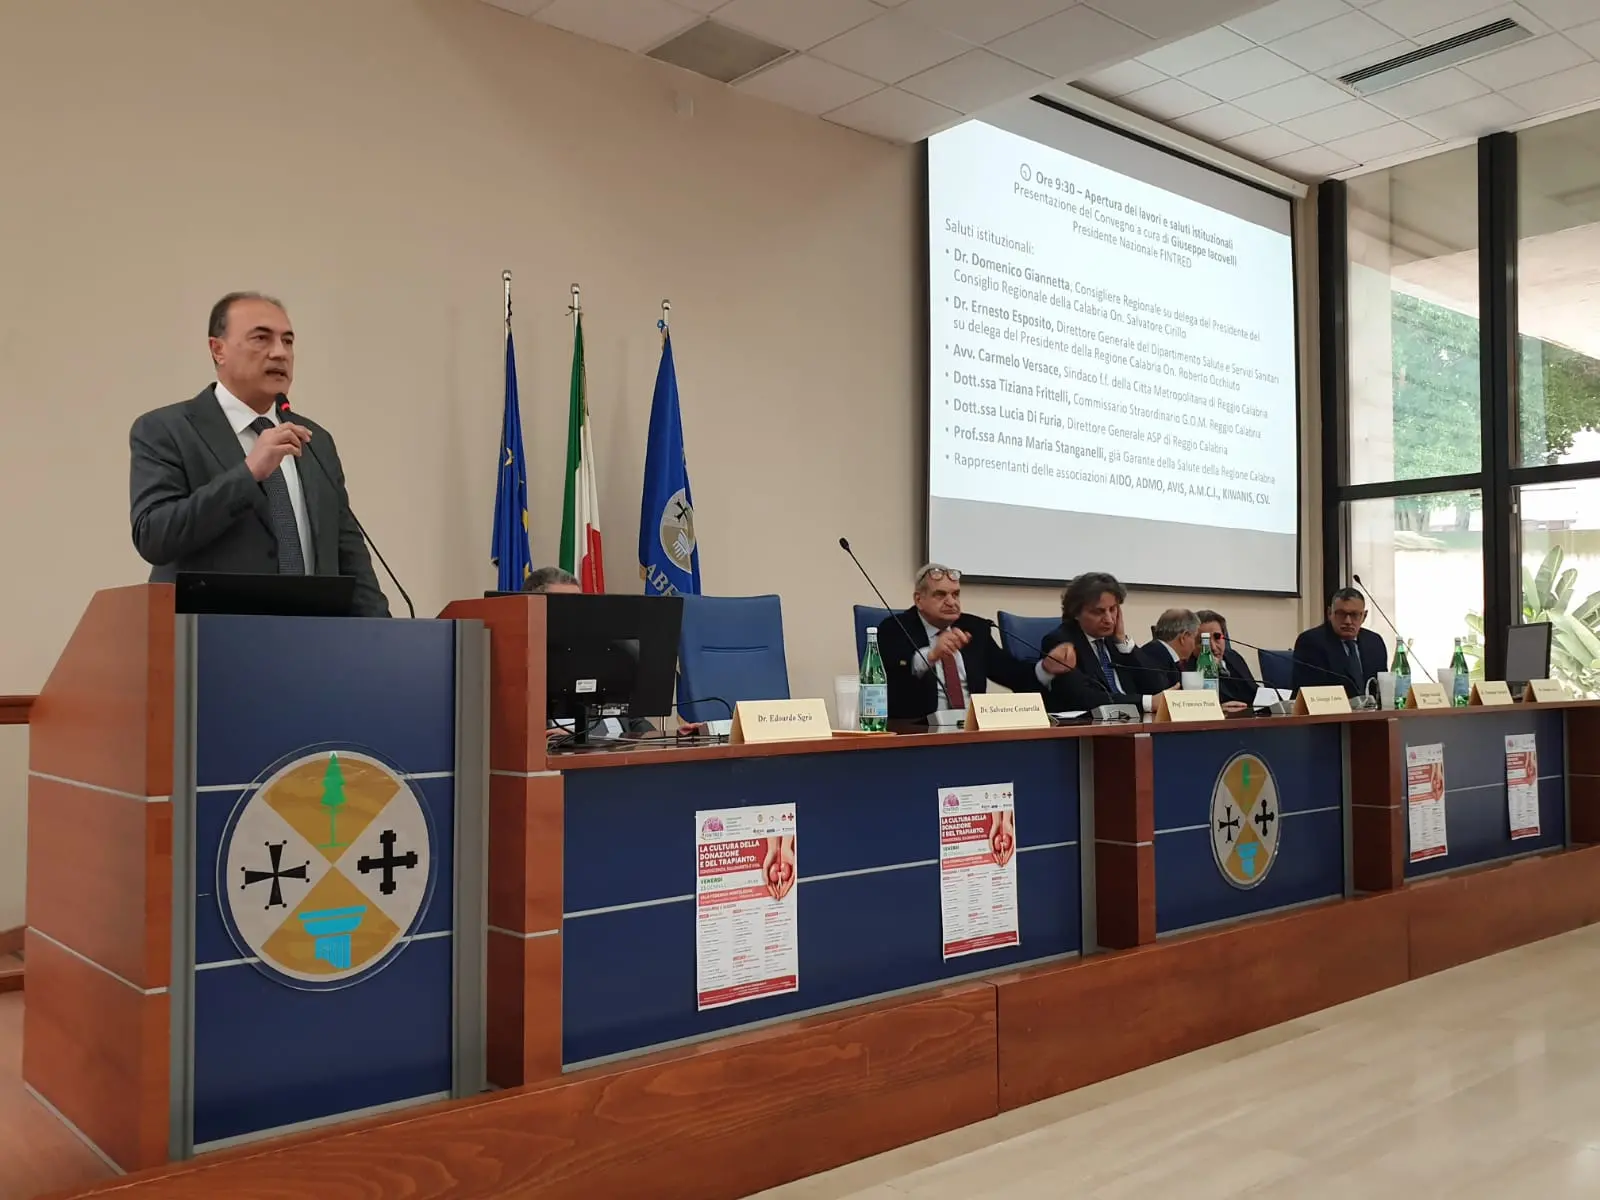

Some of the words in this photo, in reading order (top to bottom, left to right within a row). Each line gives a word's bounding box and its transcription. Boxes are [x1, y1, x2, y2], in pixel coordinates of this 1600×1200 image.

[945, 216, 973, 237] Saluti
[976, 225, 1034, 255] istituzionali:
[1014, 181, 1076, 214] Presentazione
[1079, 203, 1092, 219] del
[1094, 209, 1134, 232] Convegno
[1143, 228, 1160, 241] cura
[1161, 231, 1169, 244] di
[1170, 234, 1206, 257] Giuseppe
[1036, 170, 1053, 187] Ore
[1055, 176, 1074, 195] 9:30
[1084, 187, 1122, 211] Apertura
[1139, 206, 1161, 225] lavori
[1169, 220, 1190, 235] saluti
[1192, 225, 1233, 249] istituzionali
[1072, 220, 1117, 245] Presidente
[1119, 235, 1157, 258] Nazionale
[953, 267, 999, 291] Consiglio
[1001, 280, 1047, 303] Regionale
[1049, 292, 1070, 309] della
[1073, 298, 1107, 318] Calabria
[1110, 308, 1124, 322] On.
[1126, 313, 1162, 332] Salvatore
[954, 247, 968, 264] Dr.
[971, 252, 1022, 278] Domenico
[1024, 266, 1072, 292] Giannetta,
[1074, 281, 1120, 304] Consigliere
[1123, 294, 1161, 315] Regionale
[1162, 308, 1171, 318] su
[1173, 308, 1197, 326] delega
[1212, 319, 1248, 339] Presidente
[953, 295, 968, 311] Dr.
[971, 299, 1009, 320] Ernesto
[1012, 309, 1053, 331] Esposito,
[1056, 320, 1095, 340] Direttore
[1097, 330, 1134, 349] Generale
[1151, 343, 1200, 364] Dipartimento
[1202, 355, 1224, 371] Salute
[953, 318, 964, 330] su
[968, 318, 1000, 339] delega
[1003, 326, 1018, 341] del
[1020, 330, 1069, 352] Presidente
[1071, 341, 1092, 357] della
[1094, 347, 1127, 365] Regione
[1129, 355, 1160, 372] Calabria
[1163, 363, 1176, 376] On.
[1178, 366, 1207, 383] Roberto
[1209, 374, 1240, 391] Occhiuto
[953, 343, 975, 359] Avv.
[978, 347, 1019, 368] Carmelo
[1022, 357, 1061, 378] Versace,
[1063, 365, 1097, 383] Sindaco
[1111, 375, 1131, 390] della
[1153, 384, 1207, 405] Metropolitana
[1208, 395, 1214, 407] di
[1217, 398, 1240, 413] Reggio
[1241, 403, 1267, 418] Calabria
[953, 370, 996, 390] Dott.ssa
[998, 378, 1033, 396] Tiziana
[1036, 385, 1070, 405] Frittelli,
[1073, 392, 1127, 414] Commissario
[1129, 403, 1180, 423] Straordinario
[1209, 418, 1233, 434] Reggio
[953, 397, 996, 417] Dott.ssa
[999, 405, 1024, 421] Lucia
[1027, 409, 1036, 423] Di
[1039, 412, 1064, 429] Furia,
[1067, 416, 1105, 434] Direttore
[1108, 423, 1144, 441] Generale
[1146, 430, 1161, 444] ASP
[1163, 433, 1170, 445] di
[1173, 435, 1197, 451] Reggio
[1199, 440, 1227, 455] Calabria
[954, 424, 994, 443] Prof.ssa
[997, 431, 1022, 447] Anna
[1025, 435, 1052, 451] Maria
[1055, 439, 1106, 460] Stanganelli,
[1123, 450, 1154, 466] Garante
[1156, 455, 1175, 469] della
[1177, 459, 1199, 473] Salute
[1201, 462, 1219, 476] della
[1221, 465, 1248, 480] Regione
[1249, 470, 1275, 484] Calabria
[954, 452, 1028, 472] Rappresentanti
[1031, 462, 1053, 476] delle
[1055, 469, 1106, 483] associazioni
[1109, 473, 1133, 488] AIDO,
[1135, 476, 1164, 492] ADMO,
[1166, 481, 1186, 496] AVIS,
[1222, 488, 1254, 504] KIWANIS,
[758, 714, 767, 722] Dr.
[769, 714, 796, 722] Edoardo
[989, 705, 1014, 713] Salvatore
[700, 850, 740, 860] DONAZIONE
[709, 842, 739, 851] CULTURA
[740, 840, 760, 848] DELLA
